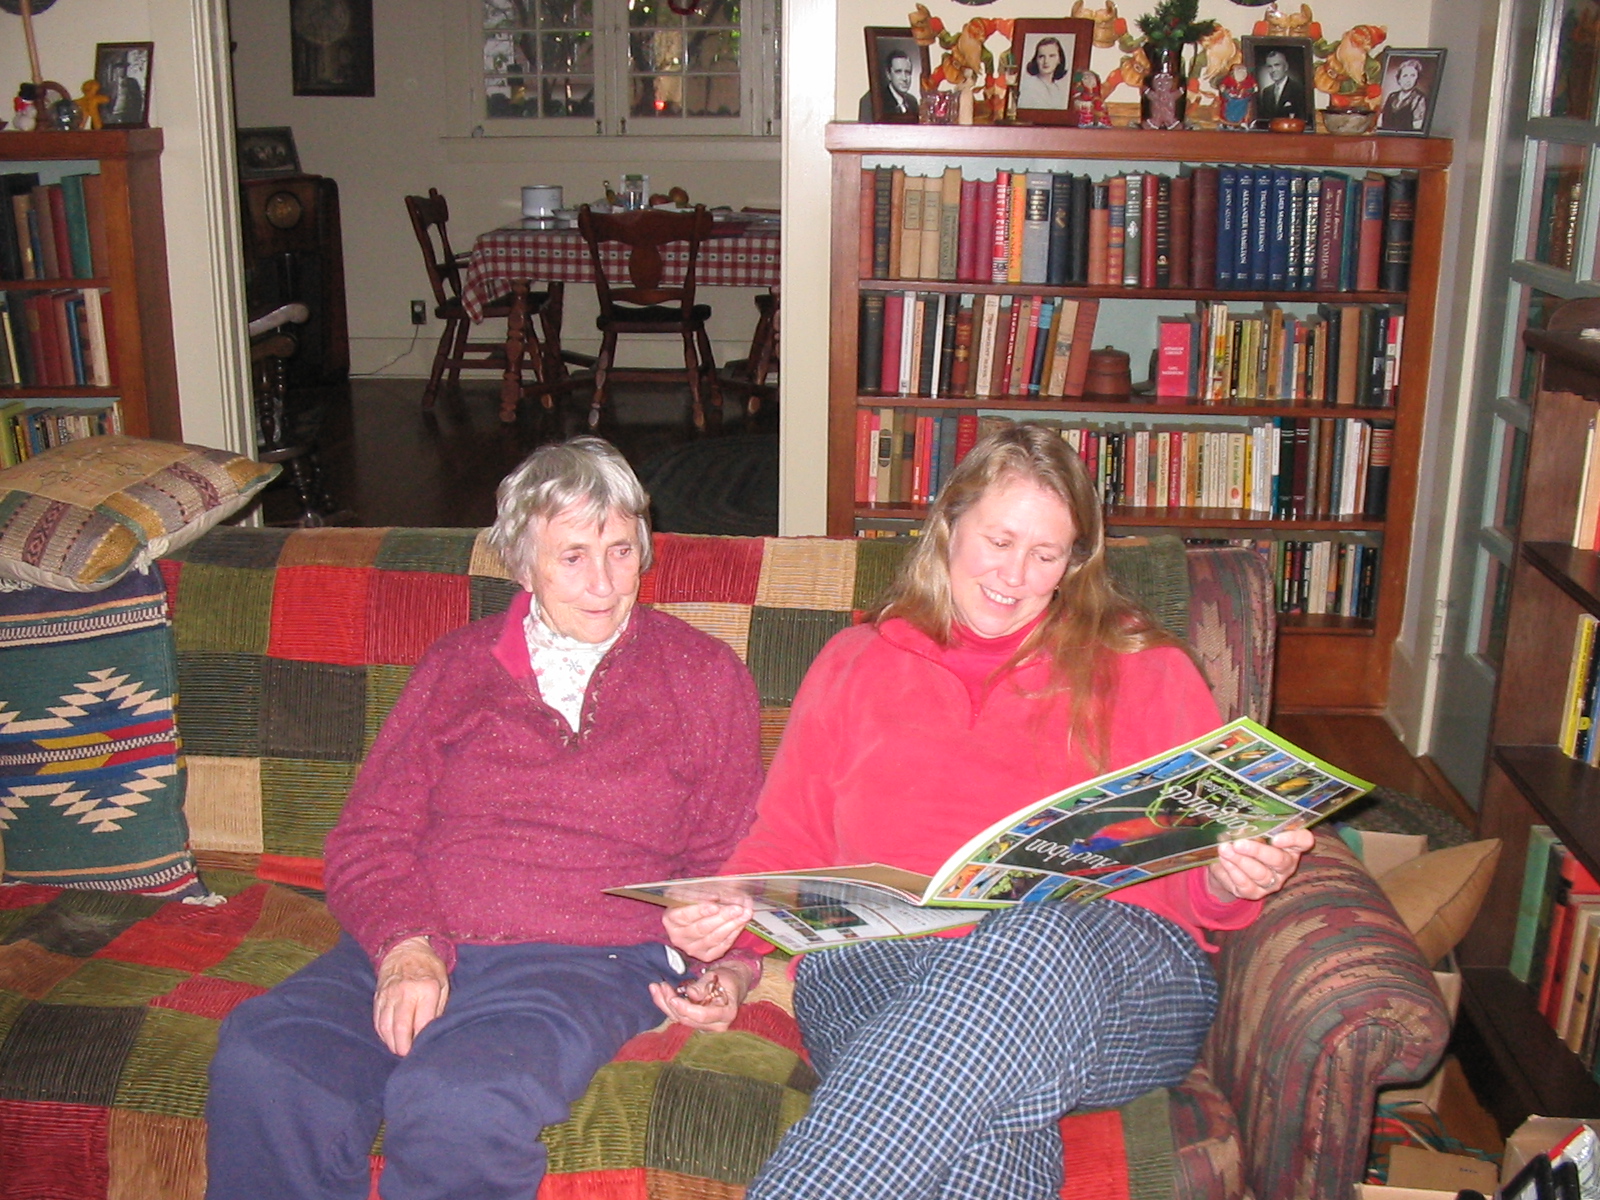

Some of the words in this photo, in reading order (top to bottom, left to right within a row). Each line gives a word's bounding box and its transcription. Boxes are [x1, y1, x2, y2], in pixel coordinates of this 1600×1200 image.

[943, 215, 951, 237] MARK
[1241, 189, 1250, 229] ALEXANDER
[1323, 203, 1332, 235] MORAL
[1240, 229, 1248, 264] HAMILTON
[1258, 217, 1266, 252] JEFFERSON
[942, 240, 950, 267] TWAIN
[1320, 238, 1331, 280] COMPASS
[1159, 785, 1259, 837] Songbirds
[1023, 838, 1120, 869] Audubon
